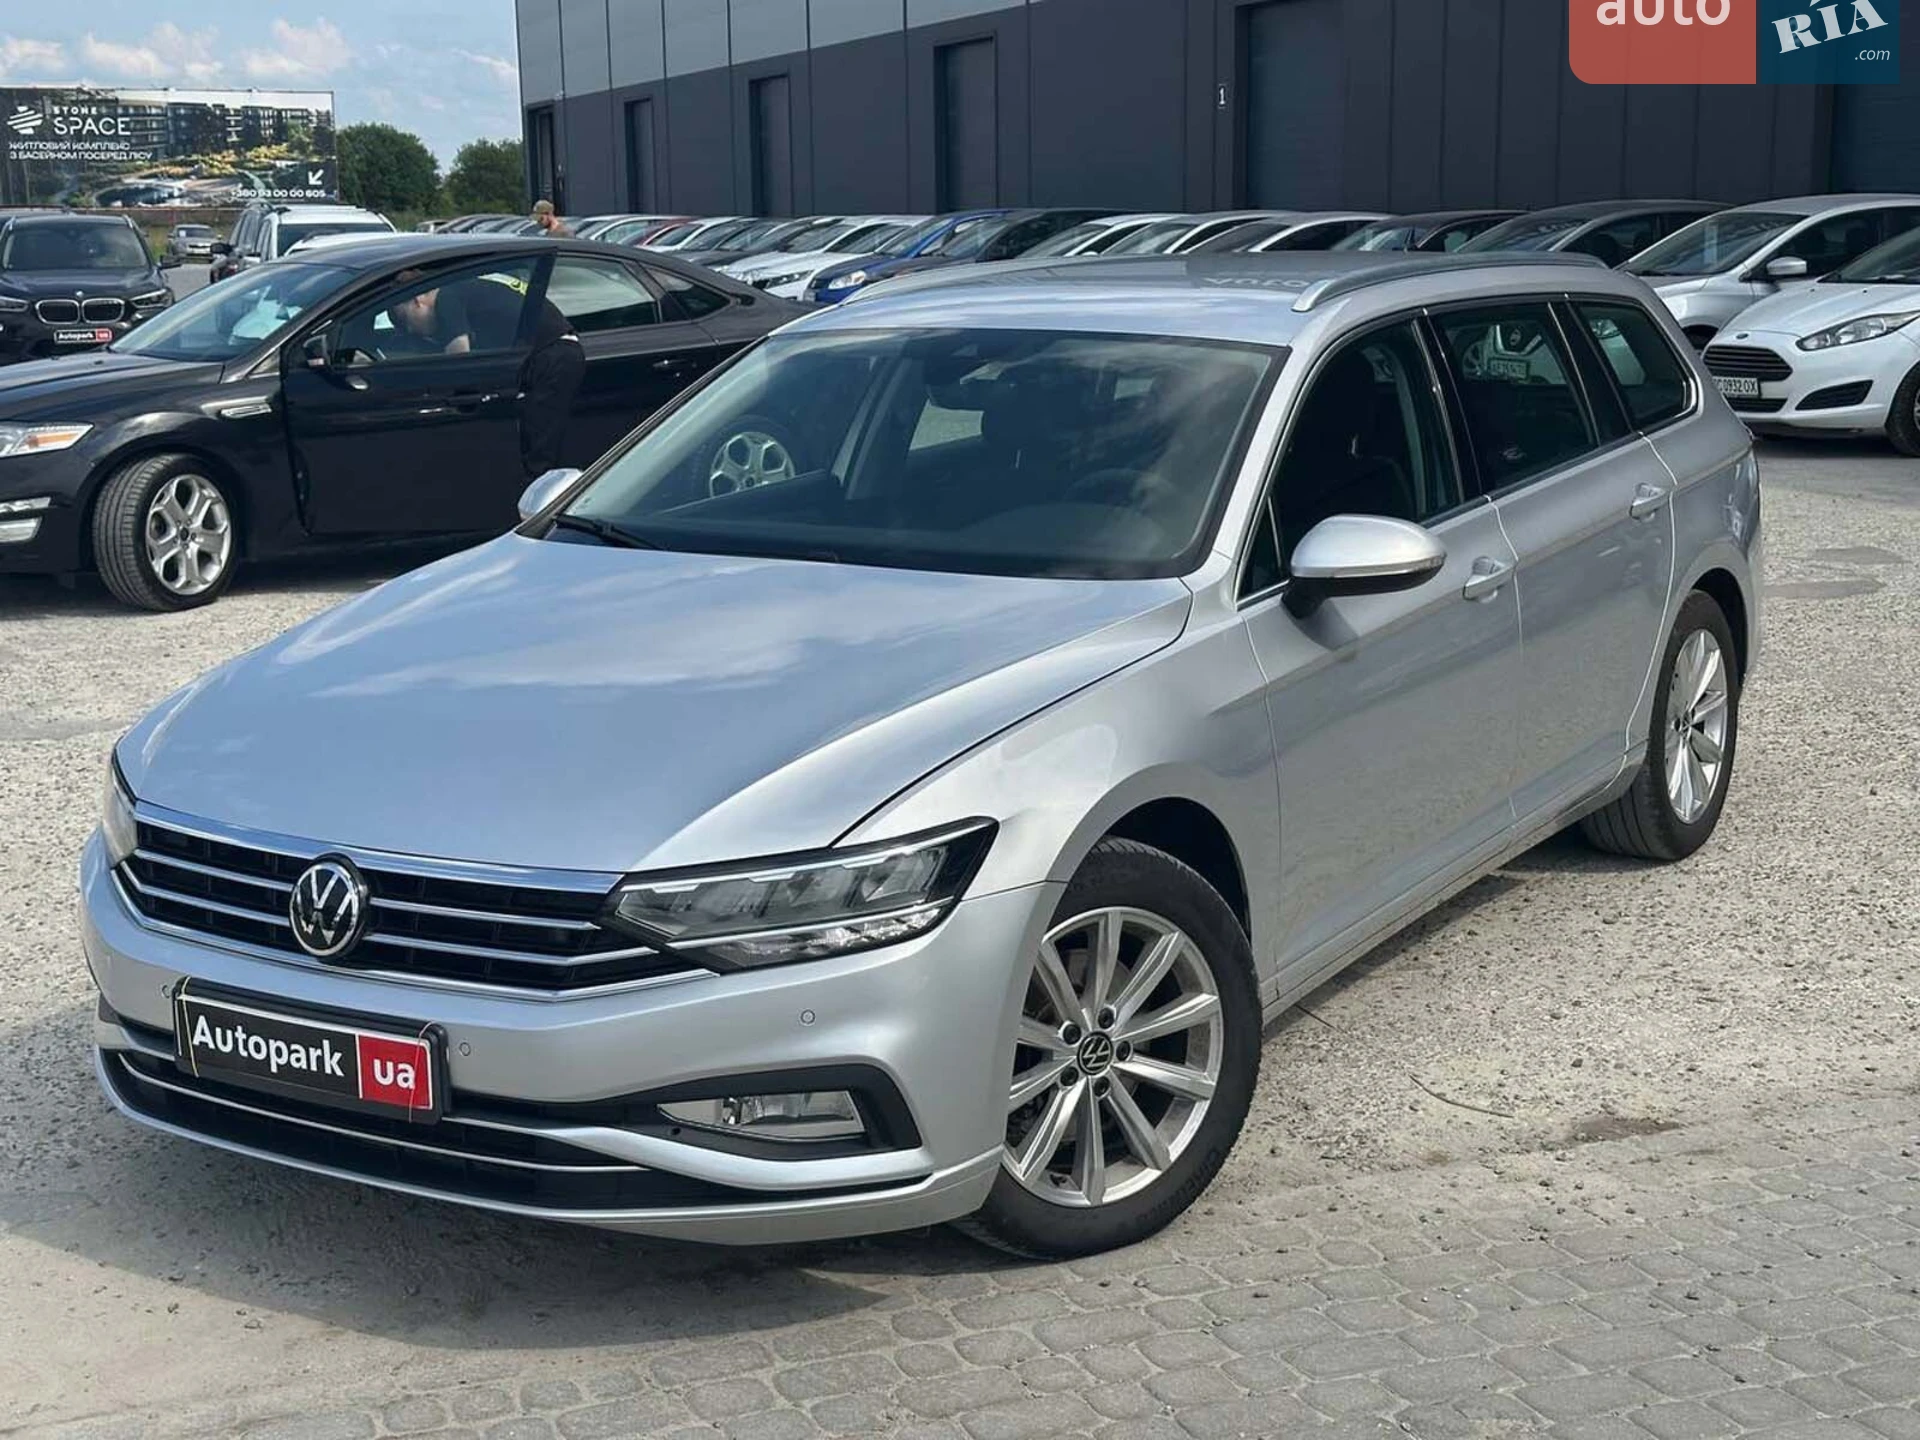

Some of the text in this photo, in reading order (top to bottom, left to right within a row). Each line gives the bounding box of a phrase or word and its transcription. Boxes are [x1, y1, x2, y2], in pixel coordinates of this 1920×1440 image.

[52, 106, 98, 115] STONE
[53, 116, 131, 136] SPACE
[9, 140, 131, 151] ЖИТЛОВИЙ КОМПЛЕКС
[18, 150, 77, 160] БАСЕЙНОМ
[78, 151, 127, 161] ПОСЕРЕД
[273, 188, 288, 198] 00
[289, 188, 304, 198] 00
[58, 332, 94, 340] Autopark
[192, 1014, 416, 1090] Autopark ua
